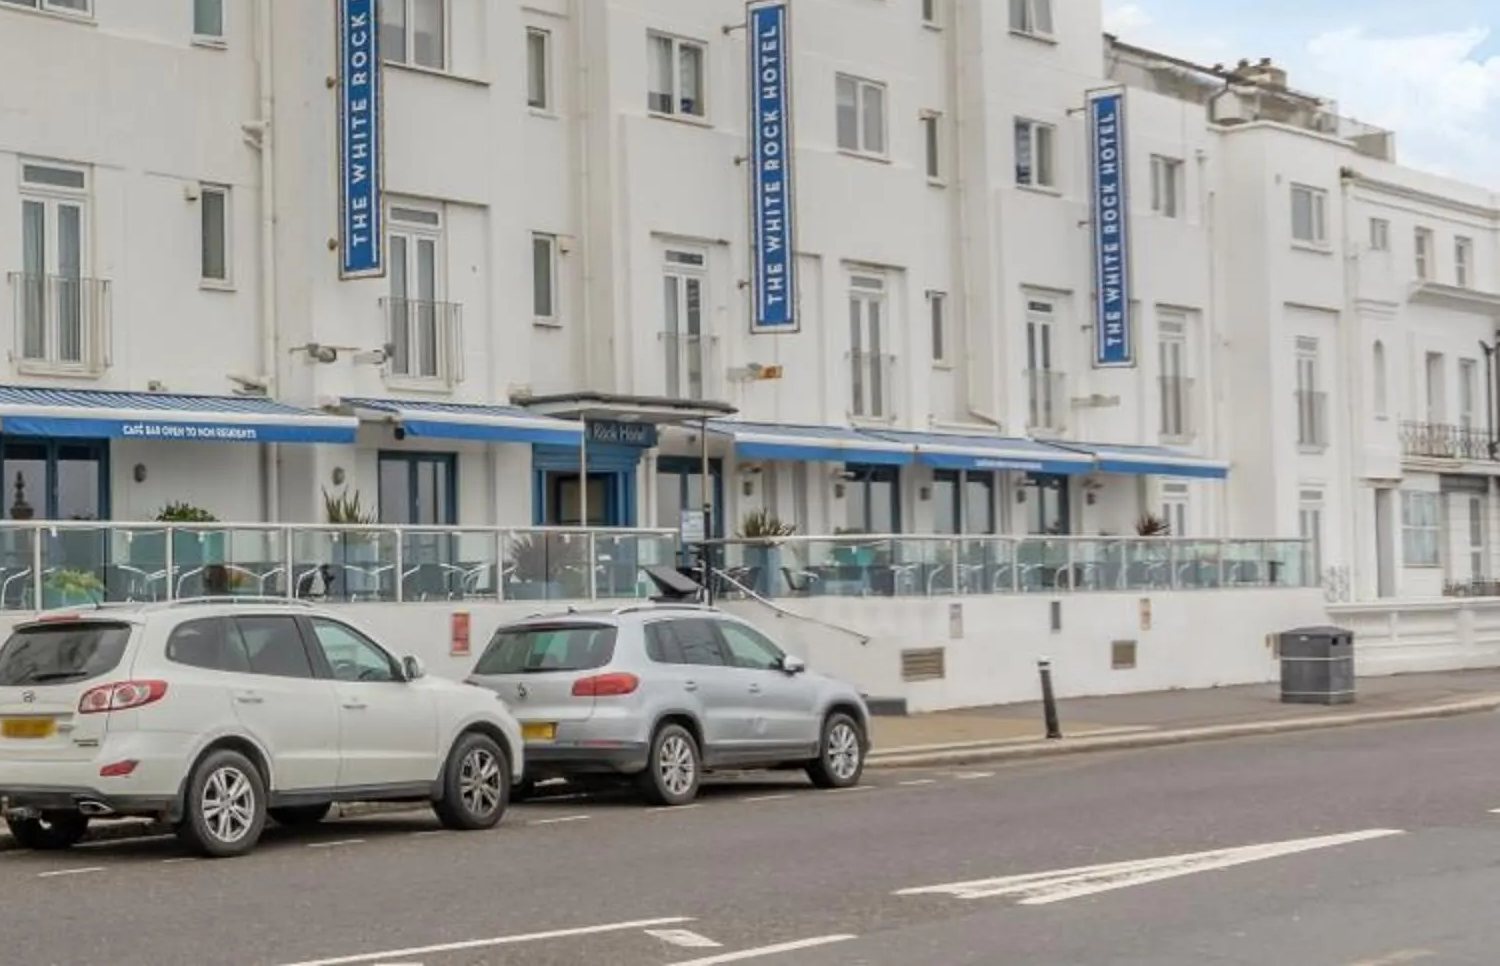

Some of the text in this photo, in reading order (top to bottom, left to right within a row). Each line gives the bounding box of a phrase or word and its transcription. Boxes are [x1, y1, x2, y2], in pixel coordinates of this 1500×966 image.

[351, 12, 367, 85] ROCK
[351, 99, 368, 184] WHITE
[762, 25, 783, 306] THE WHITE ROCK HOTEL
[353, 196, 368, 247] THE
[1101, 112, 1121, 347] THE WHITE ROCK HOTEL
[145, 425, 161, 435] BAR
[161, 425, 185, 437] OPEN
[185, 426, 197, 437] TO
